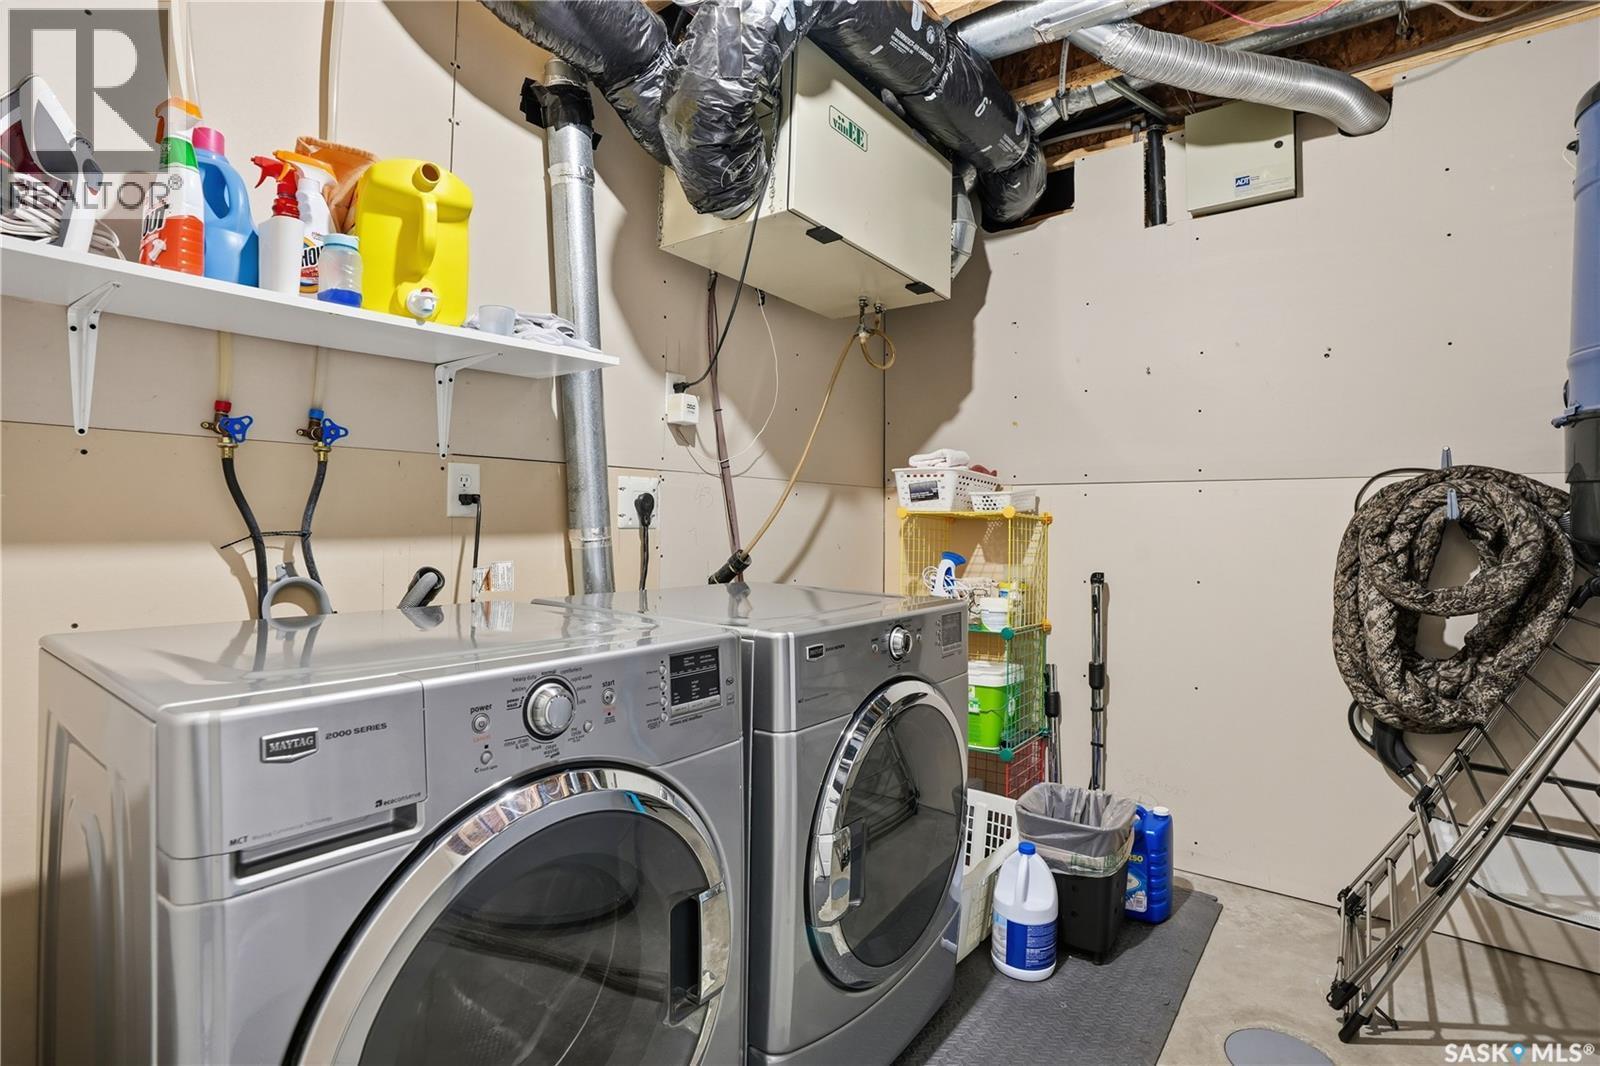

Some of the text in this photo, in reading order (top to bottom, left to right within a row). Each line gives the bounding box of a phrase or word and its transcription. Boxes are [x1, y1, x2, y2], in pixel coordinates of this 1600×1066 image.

[1236, 177, 1250, 186] ADT
[601, 680, 615, 688] start
[470, 703, 493, 714] power
[325, 722, 388, 740] 2000 SERIES
[269, 736, 314, 752] MAYTAG
[229, 835, 248, 846] MCT
